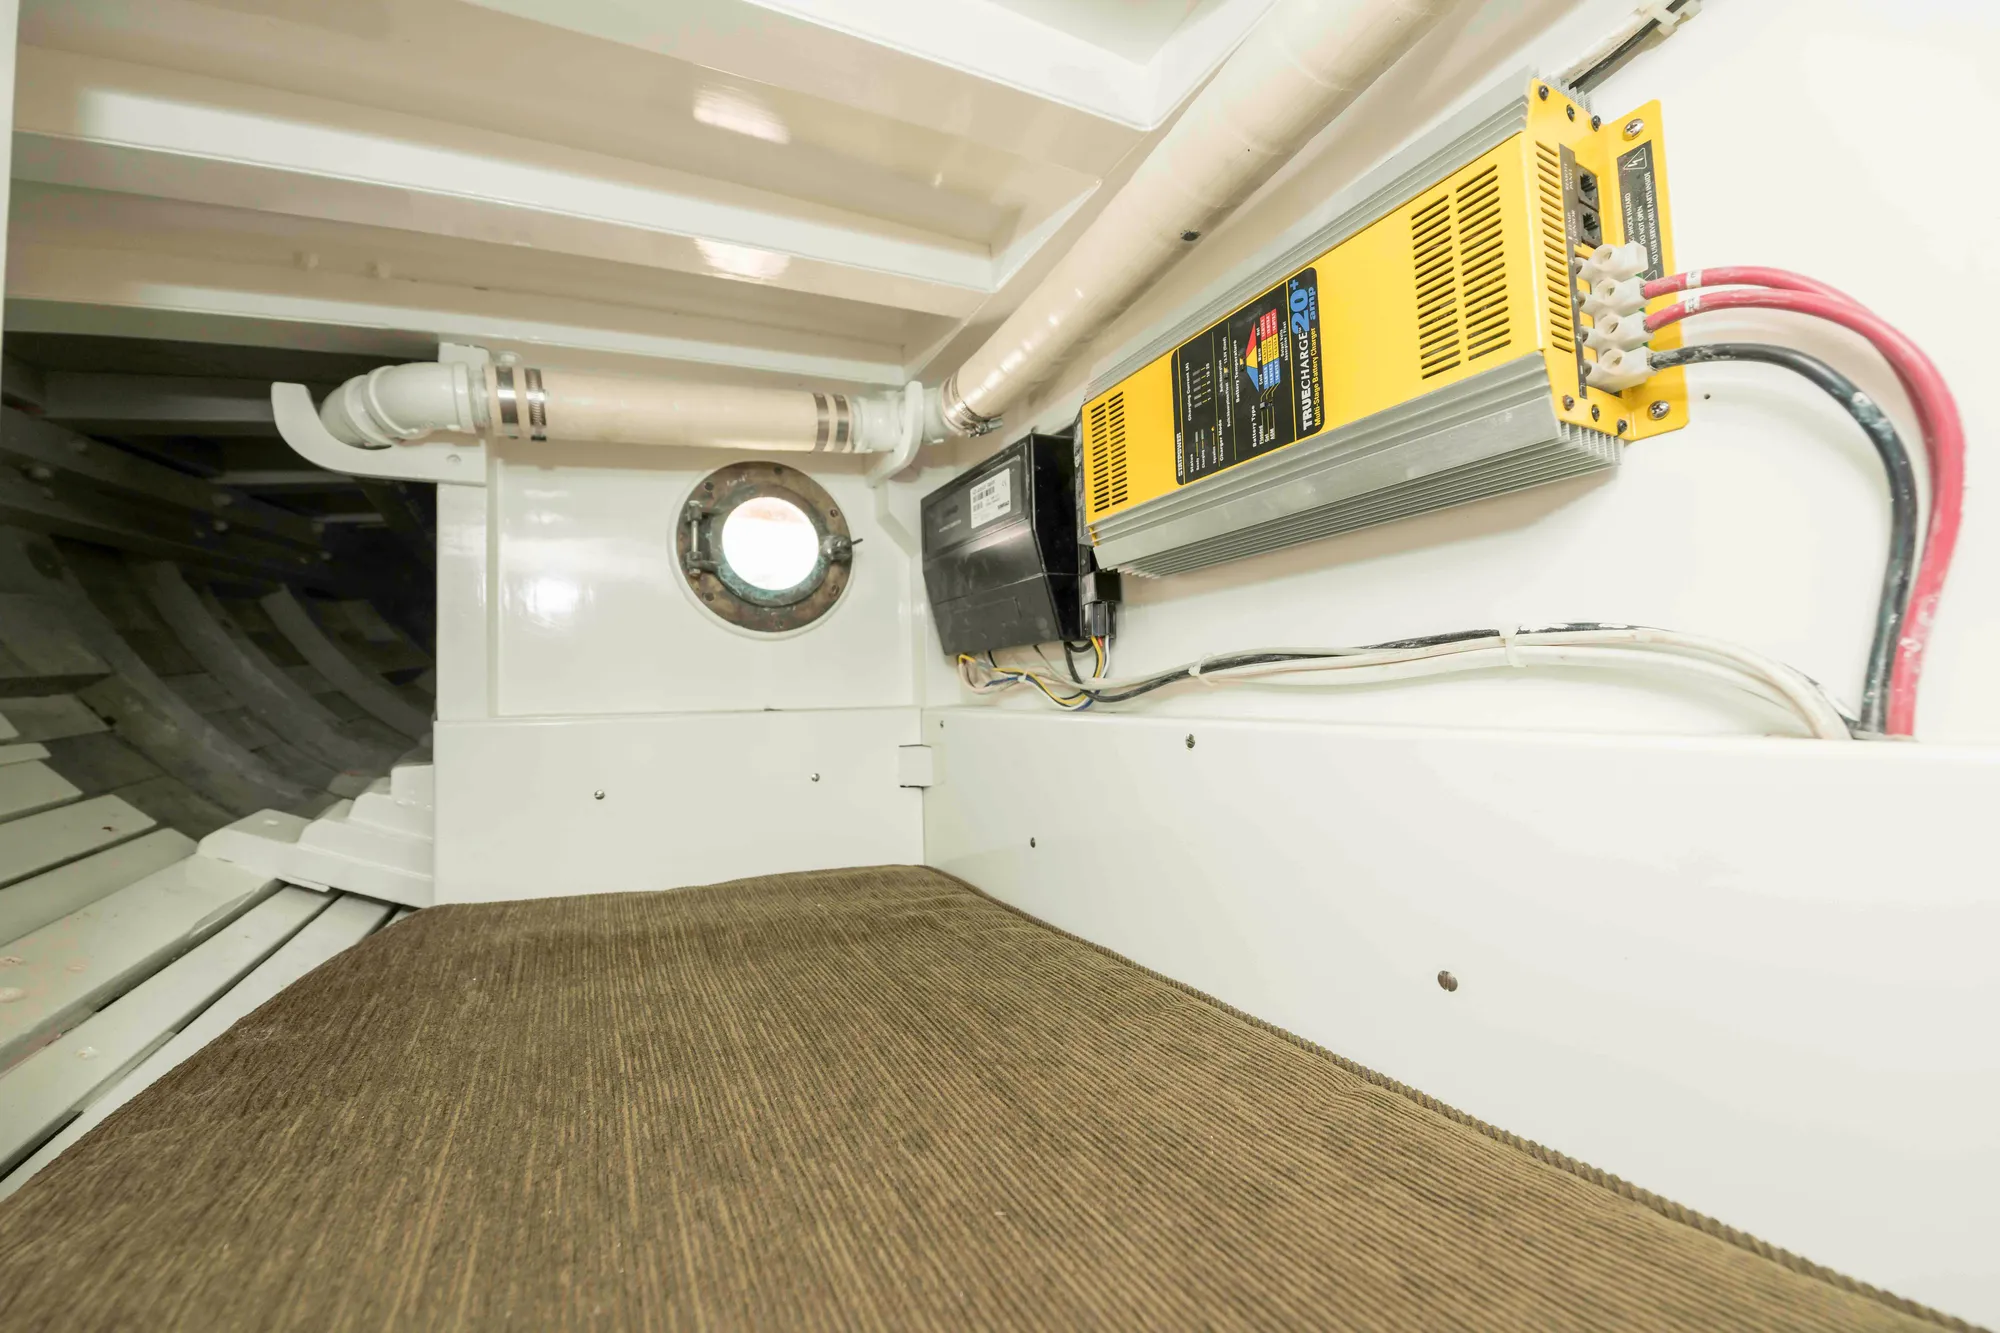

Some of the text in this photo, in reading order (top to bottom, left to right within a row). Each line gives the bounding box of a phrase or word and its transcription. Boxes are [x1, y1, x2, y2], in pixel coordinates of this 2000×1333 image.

[1644, 172, 1652, 190] INSIDE
[1624, 193, 1633, 215] HAZARD
[1645, 191, 1653, 208] PARTS
[1636, 206, 1644, 221] OPEN
[1626, 216, 1635, 235] SHOCK
[1639, 234, 1646, 244] DO
[1650, 239, 1658, 254] USER
[1651, 254, 1659, 264] NO
[1308, 287, 1316, 320] amp
[1310, 327, 1321, 426] Multi-Stage Battery Charger
